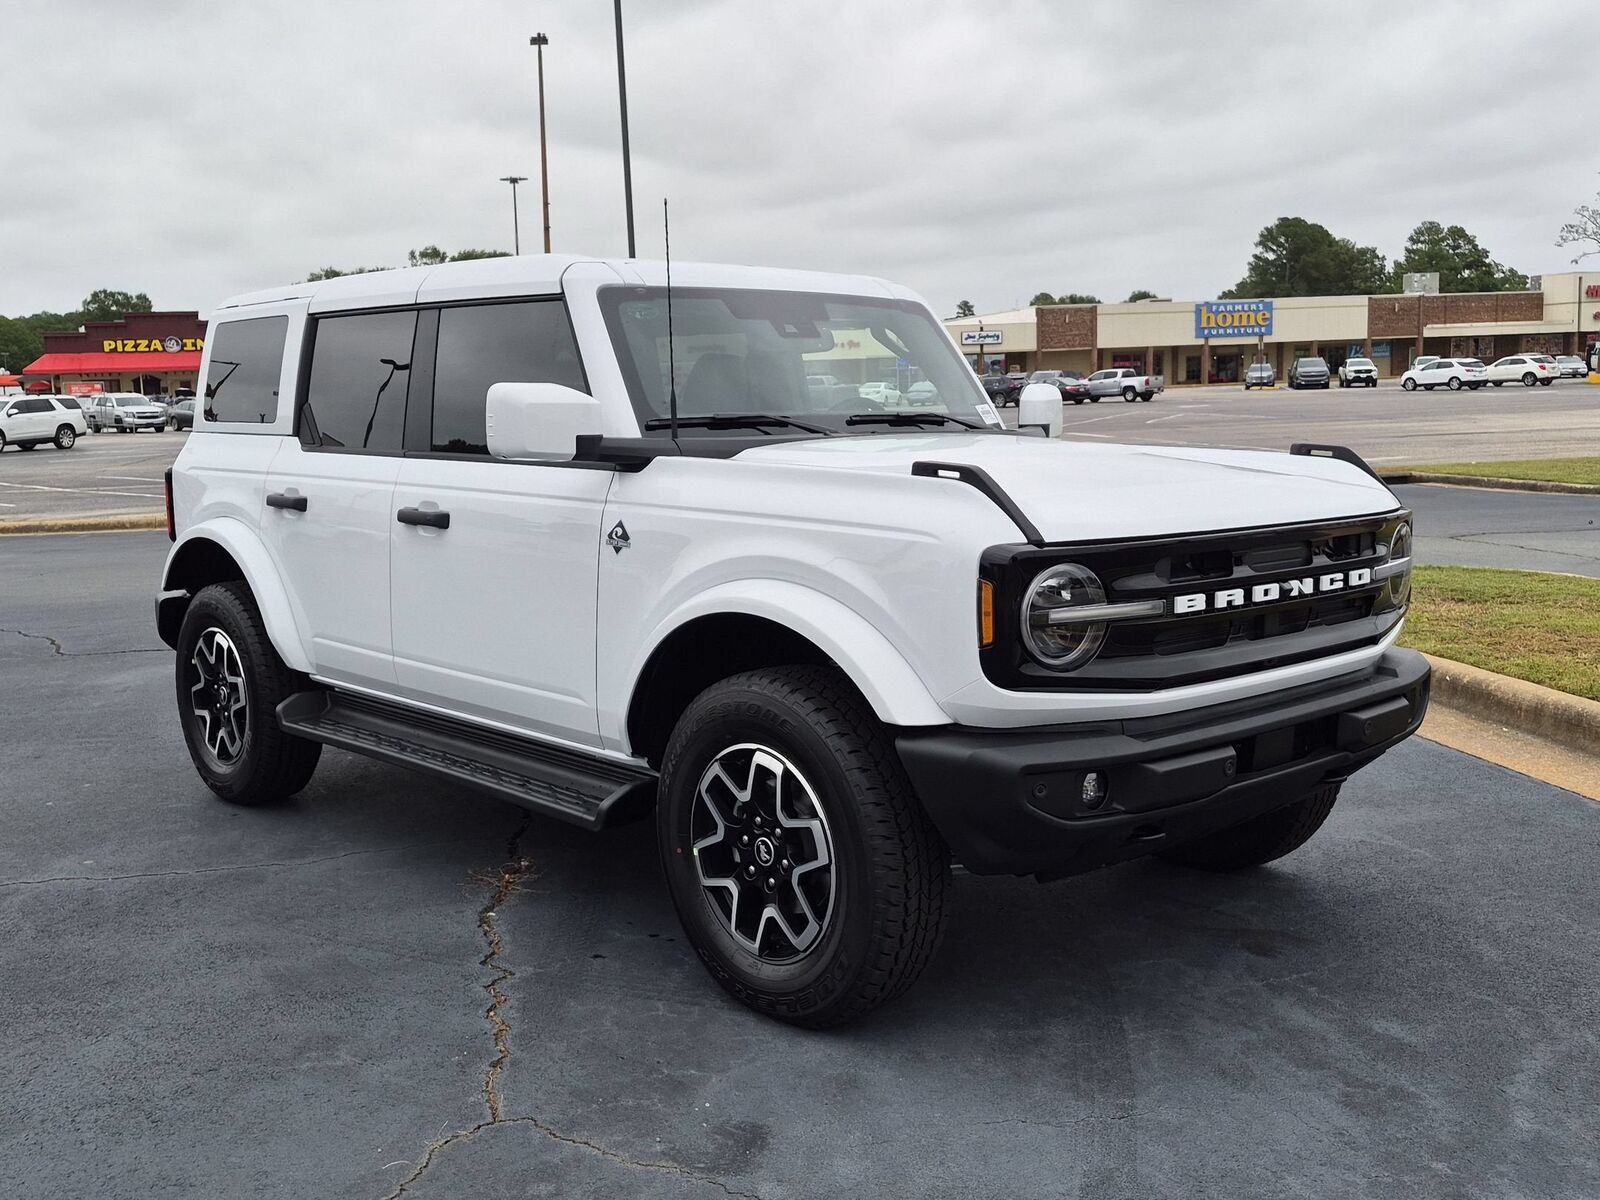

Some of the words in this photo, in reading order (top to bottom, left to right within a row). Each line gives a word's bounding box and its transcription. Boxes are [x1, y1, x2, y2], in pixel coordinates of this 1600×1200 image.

[1212, 303, 1264, 312] FARMERS
[1200, 306, 1271, 327] home
[1204, 327, 1266, 335] FURNITURE
[103, 339, 163, 352] PIZZA
[1173, 568, 1371, 614] BRONCO
